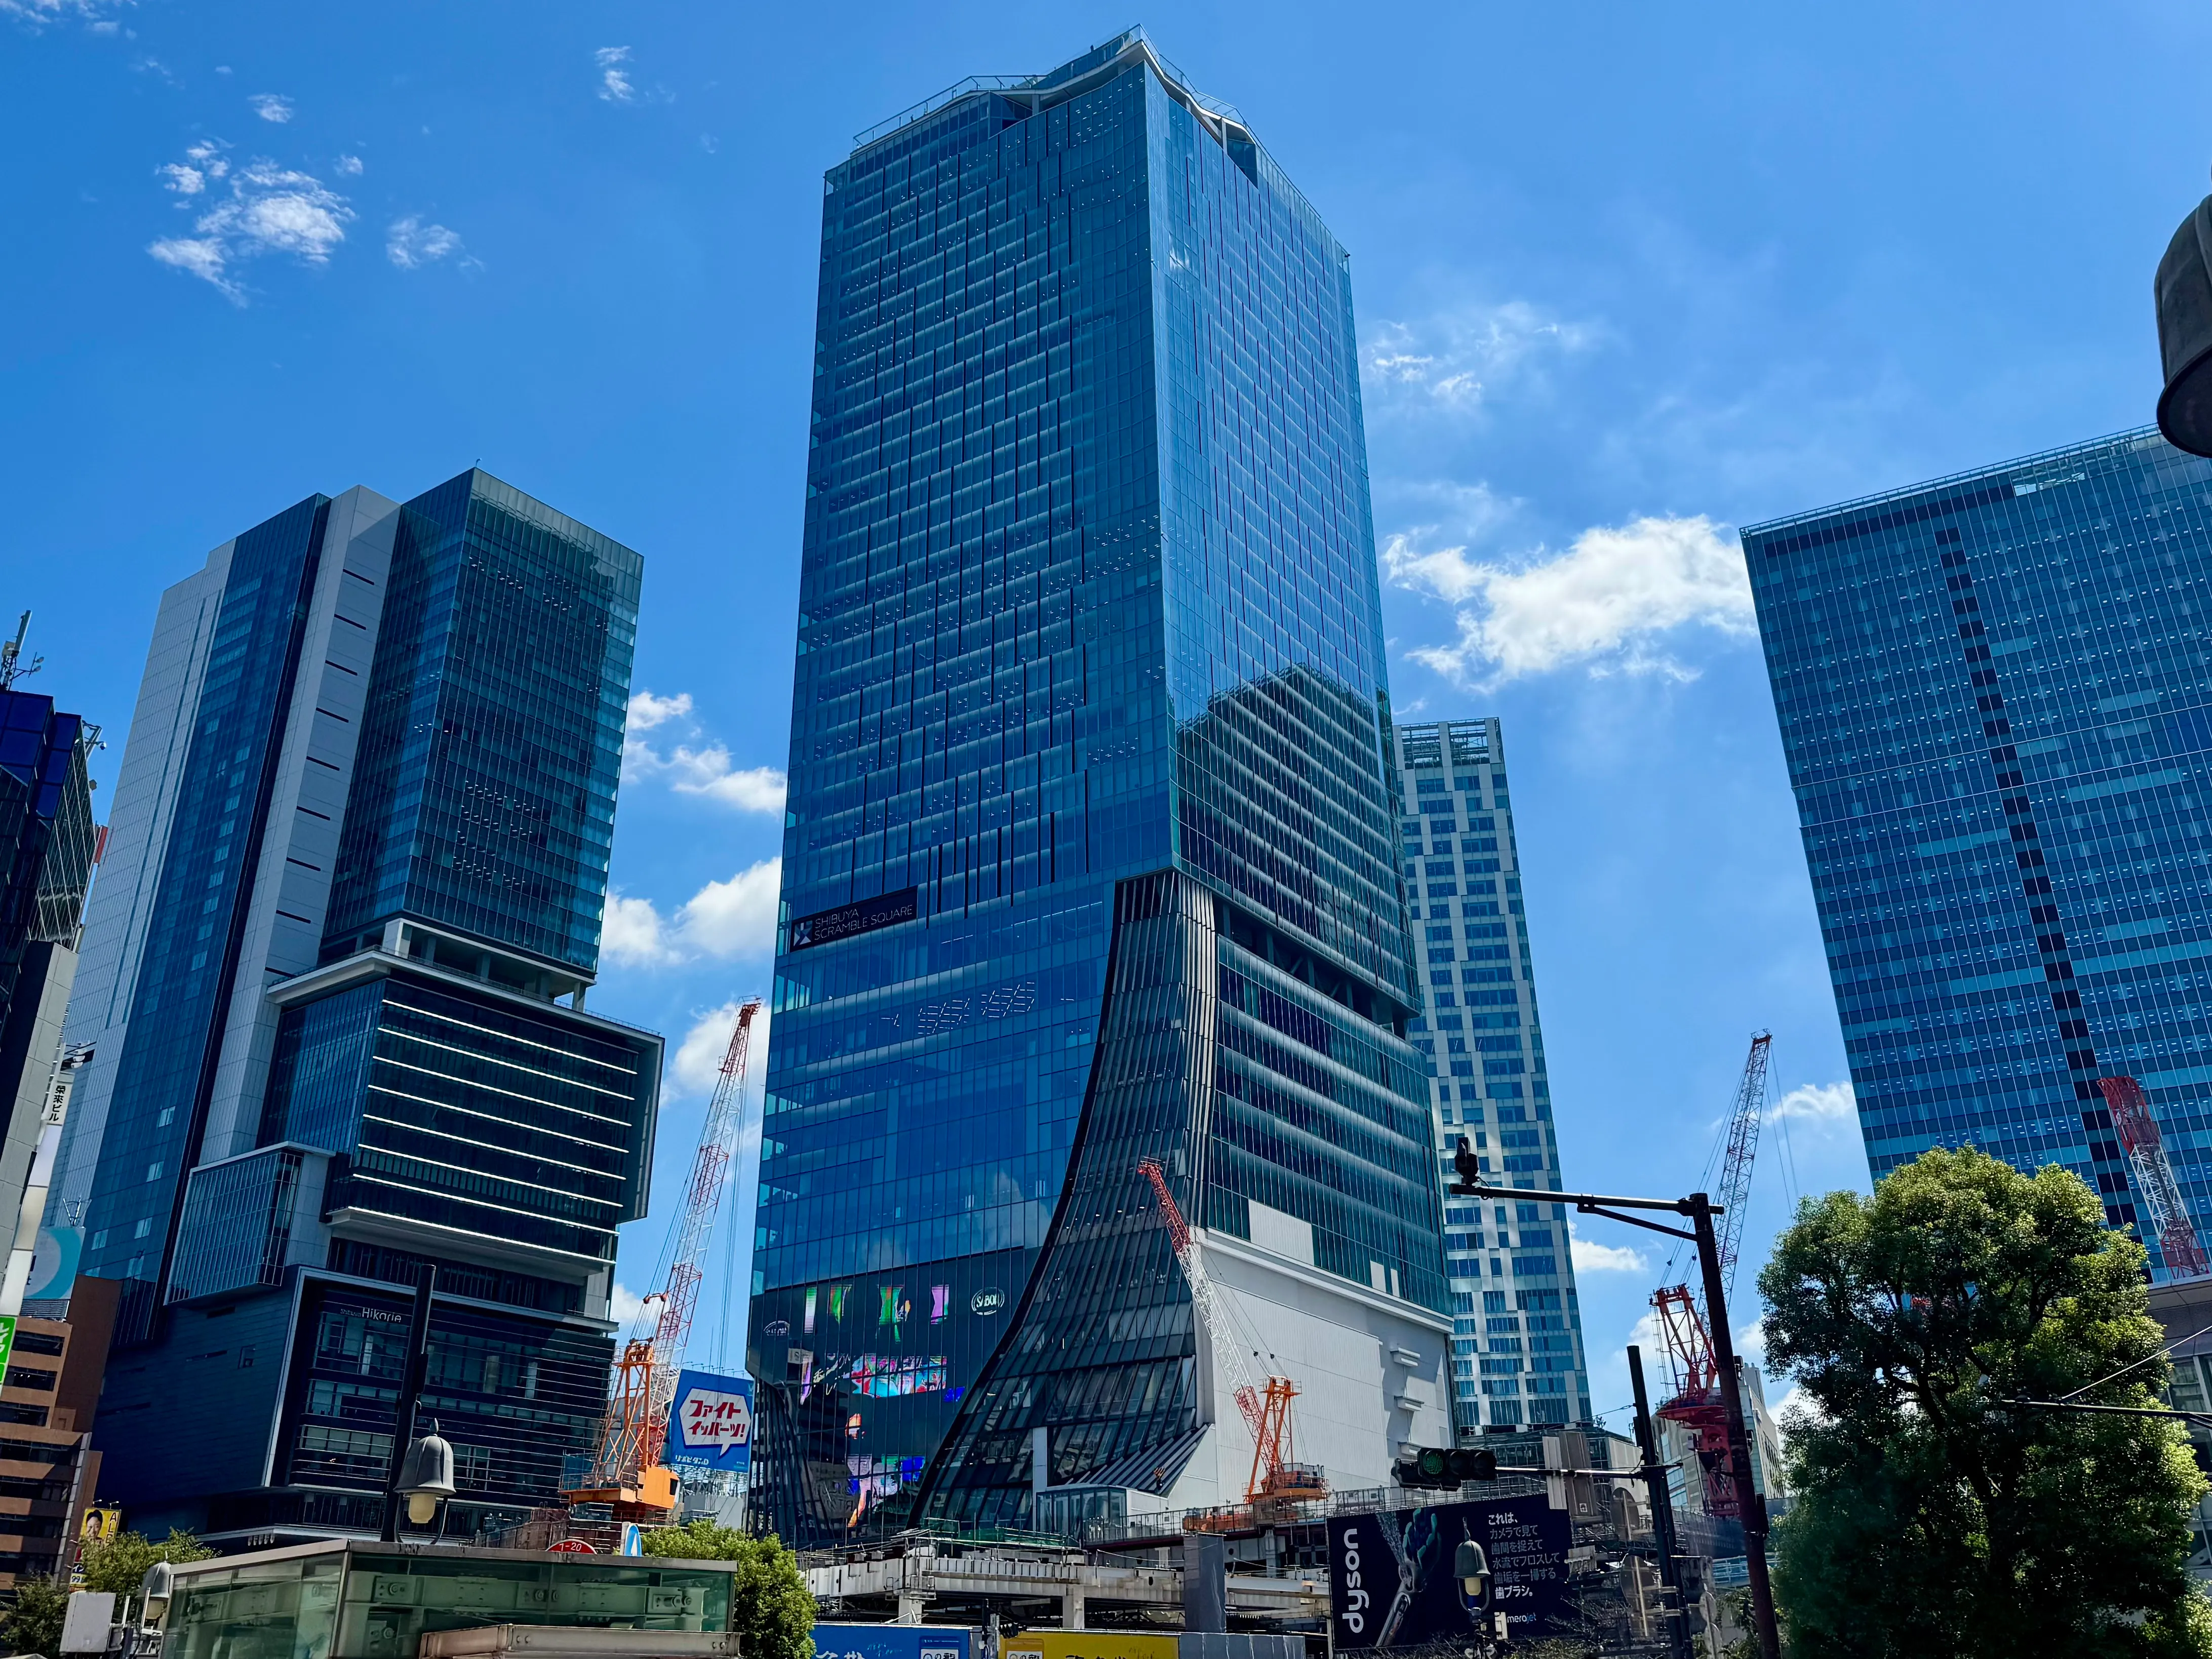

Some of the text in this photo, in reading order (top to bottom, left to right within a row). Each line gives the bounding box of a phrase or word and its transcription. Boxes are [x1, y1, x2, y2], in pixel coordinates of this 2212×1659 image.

[814, 905, 913, 940] SCRAMBLE SQUARE
[816, 908, 858, 929] SHIBUYA
[362, 1307, 402, 1323] Hikarie
[689, 1400, 741, 1419] ファイト
[688, 1421, 745, 1438] イッパーツ!
[1488, 1512, 1518, 1525] これは、
[1490, 1525, 1538, 1539] カメラで見て
[1493, 1552, 1560, 1569] 水流でフロスして
[1342, 1528, 1369, 1633] dyson
[1495, 1585, 1533, 1599] 歯ブラシ。
[1507, 1612, 1537, 1625] merojet
